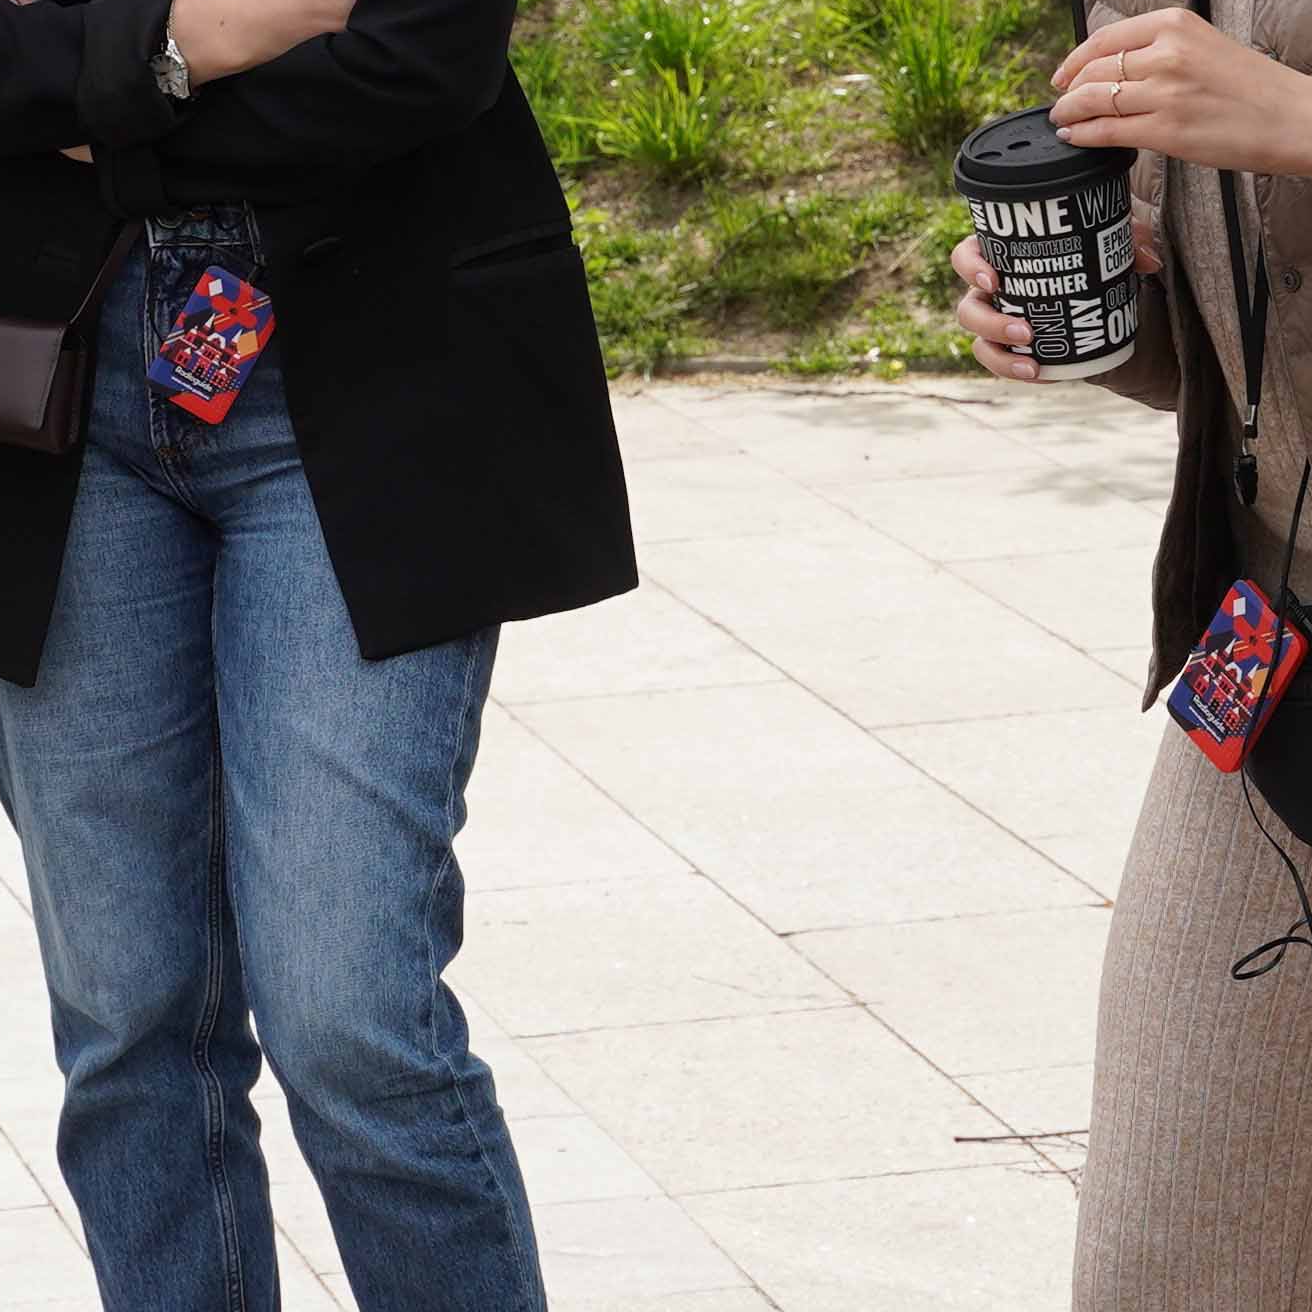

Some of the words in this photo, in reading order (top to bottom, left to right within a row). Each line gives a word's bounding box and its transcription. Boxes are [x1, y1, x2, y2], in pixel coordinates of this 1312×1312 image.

[984, 196, 1073, 238] ONE
[1075, 175, 1129, 229] WA
[1009, 236, 1083, 257] ANOTHER
[1013, 253, 1084, 274] ANOTHER
[1004, 272, 1089, 298] ANOTHER
[1027, 300, 1070, 359] ONE
[1069, 297, 1106, 356] WAY
[1107, 294, 1138, 345] ON
[175, 365, 213, 393] Radioguide
[1192, 694, 1226, 735] Radioguide
